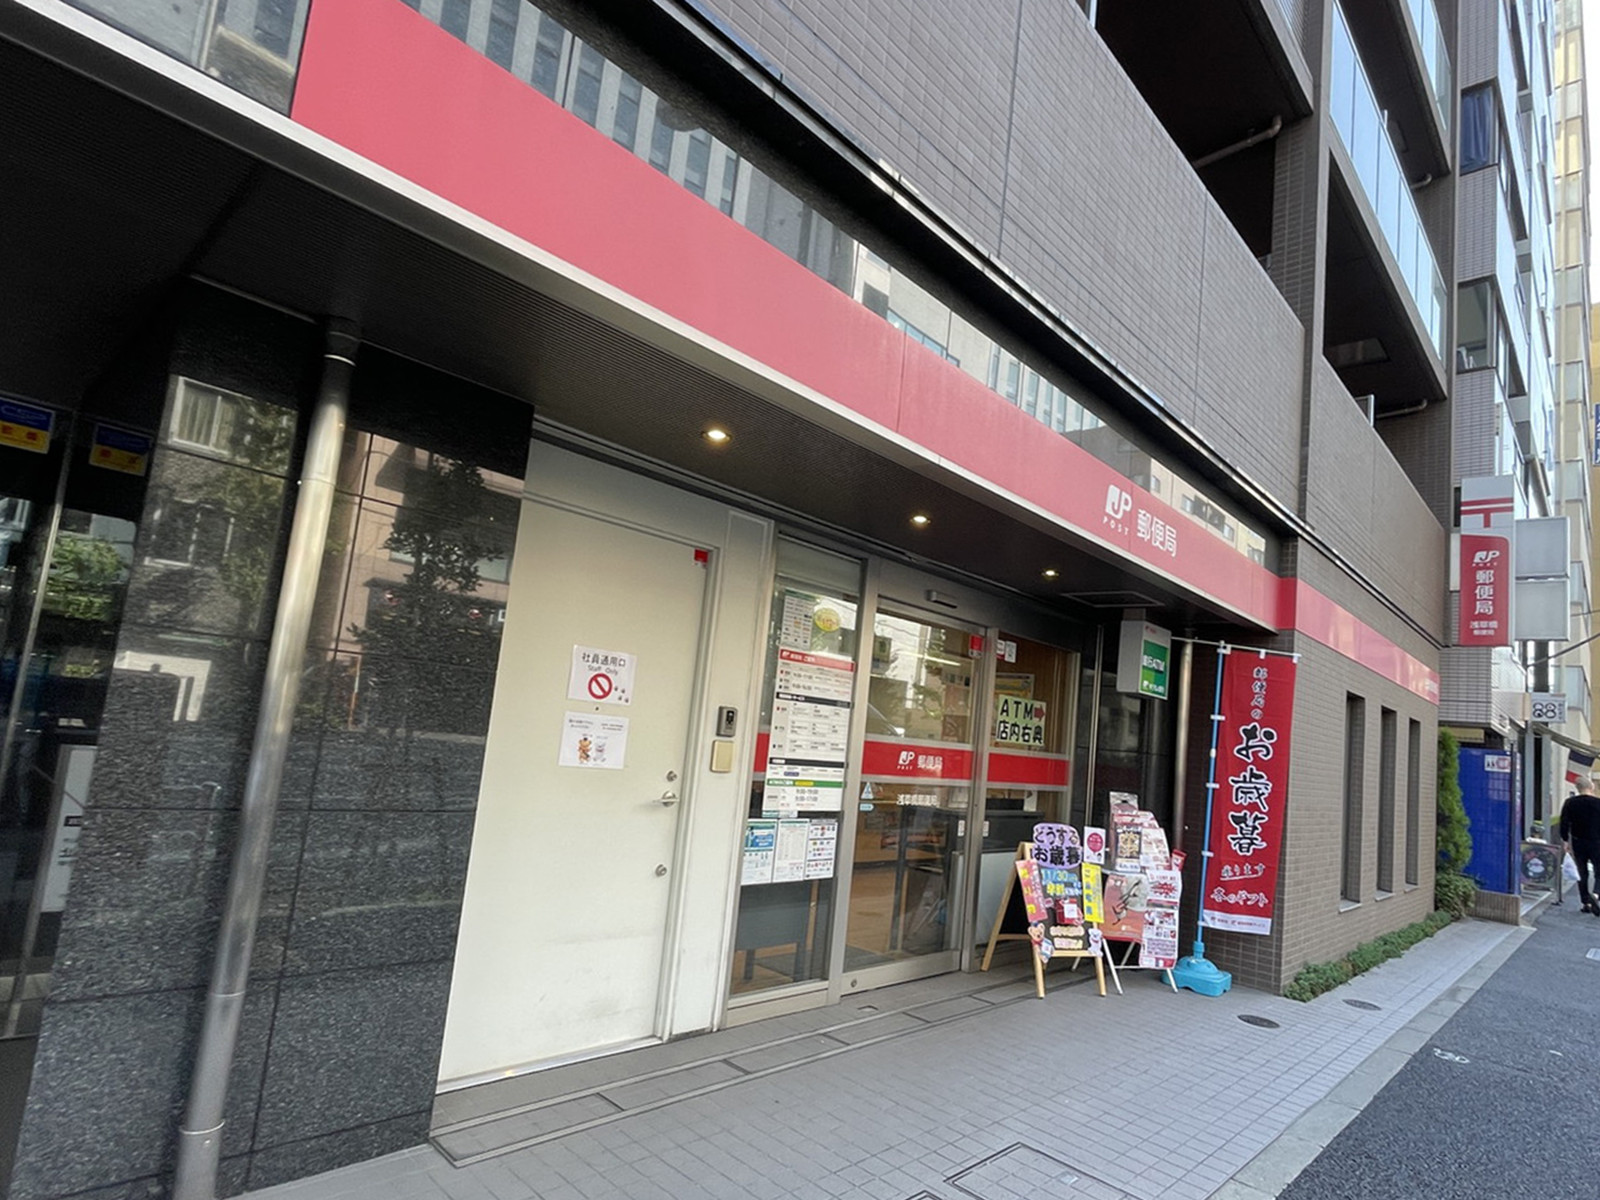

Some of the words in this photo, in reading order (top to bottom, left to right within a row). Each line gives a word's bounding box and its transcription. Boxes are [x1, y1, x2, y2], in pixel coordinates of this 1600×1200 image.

[1137, 509, 1177, 557] 郵便局
[1474, 569, 1495, 615] 郵便局
[582, 652, 626, 666] 社員通用口
[1251, 666, 1268, 720] 郵便局の
[1000, 698, 1034, 720] ATM
[997, 719, 1043, 744] 店内右奥
[917, 754, 943, 770] 郵便局
[1227, 721, 1277, 857] お歳暮
[1034, 827, 1079, 845] どうする
[1033, 846, 1081, 866] お歳暮
